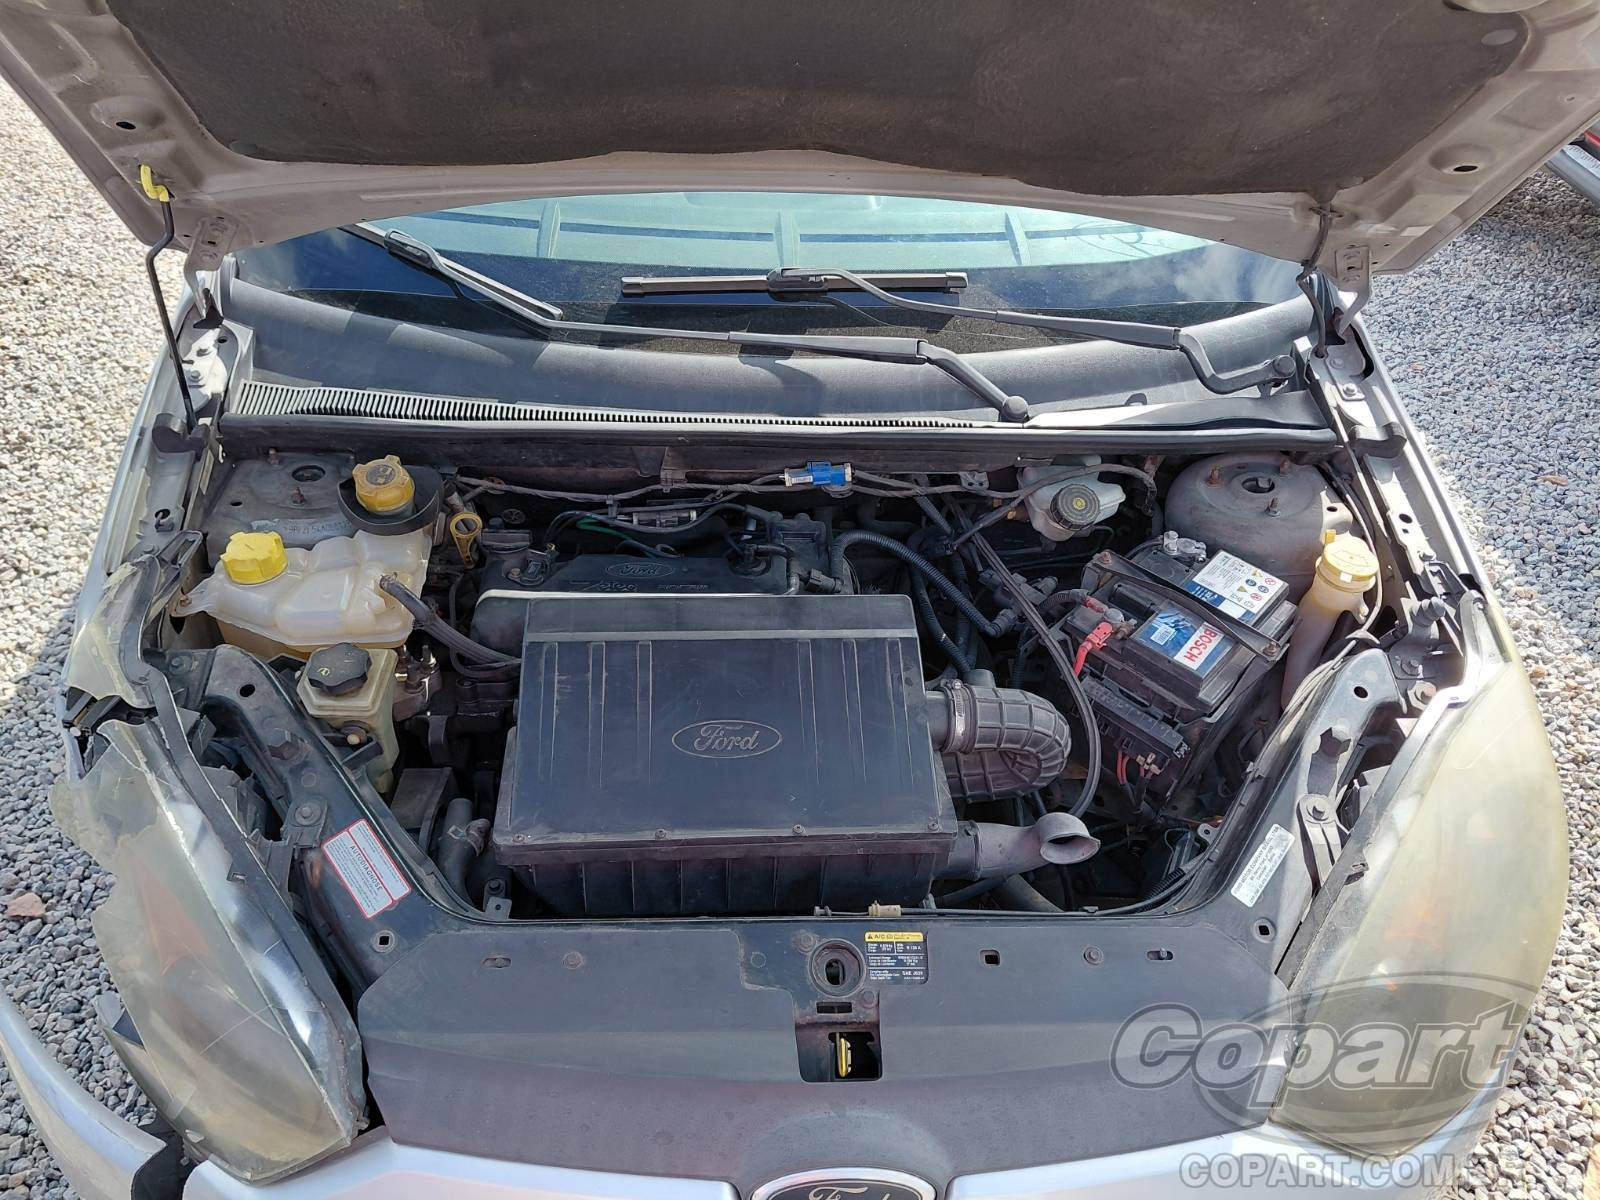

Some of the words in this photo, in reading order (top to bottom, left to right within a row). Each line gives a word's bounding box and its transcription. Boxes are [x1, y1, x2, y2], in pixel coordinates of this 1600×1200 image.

[1184, 628, 1217, 662] BOSCH
[694, 724, 760, 751] Ford
[349, 845, 383, 891] AUTODIAGNOSE
